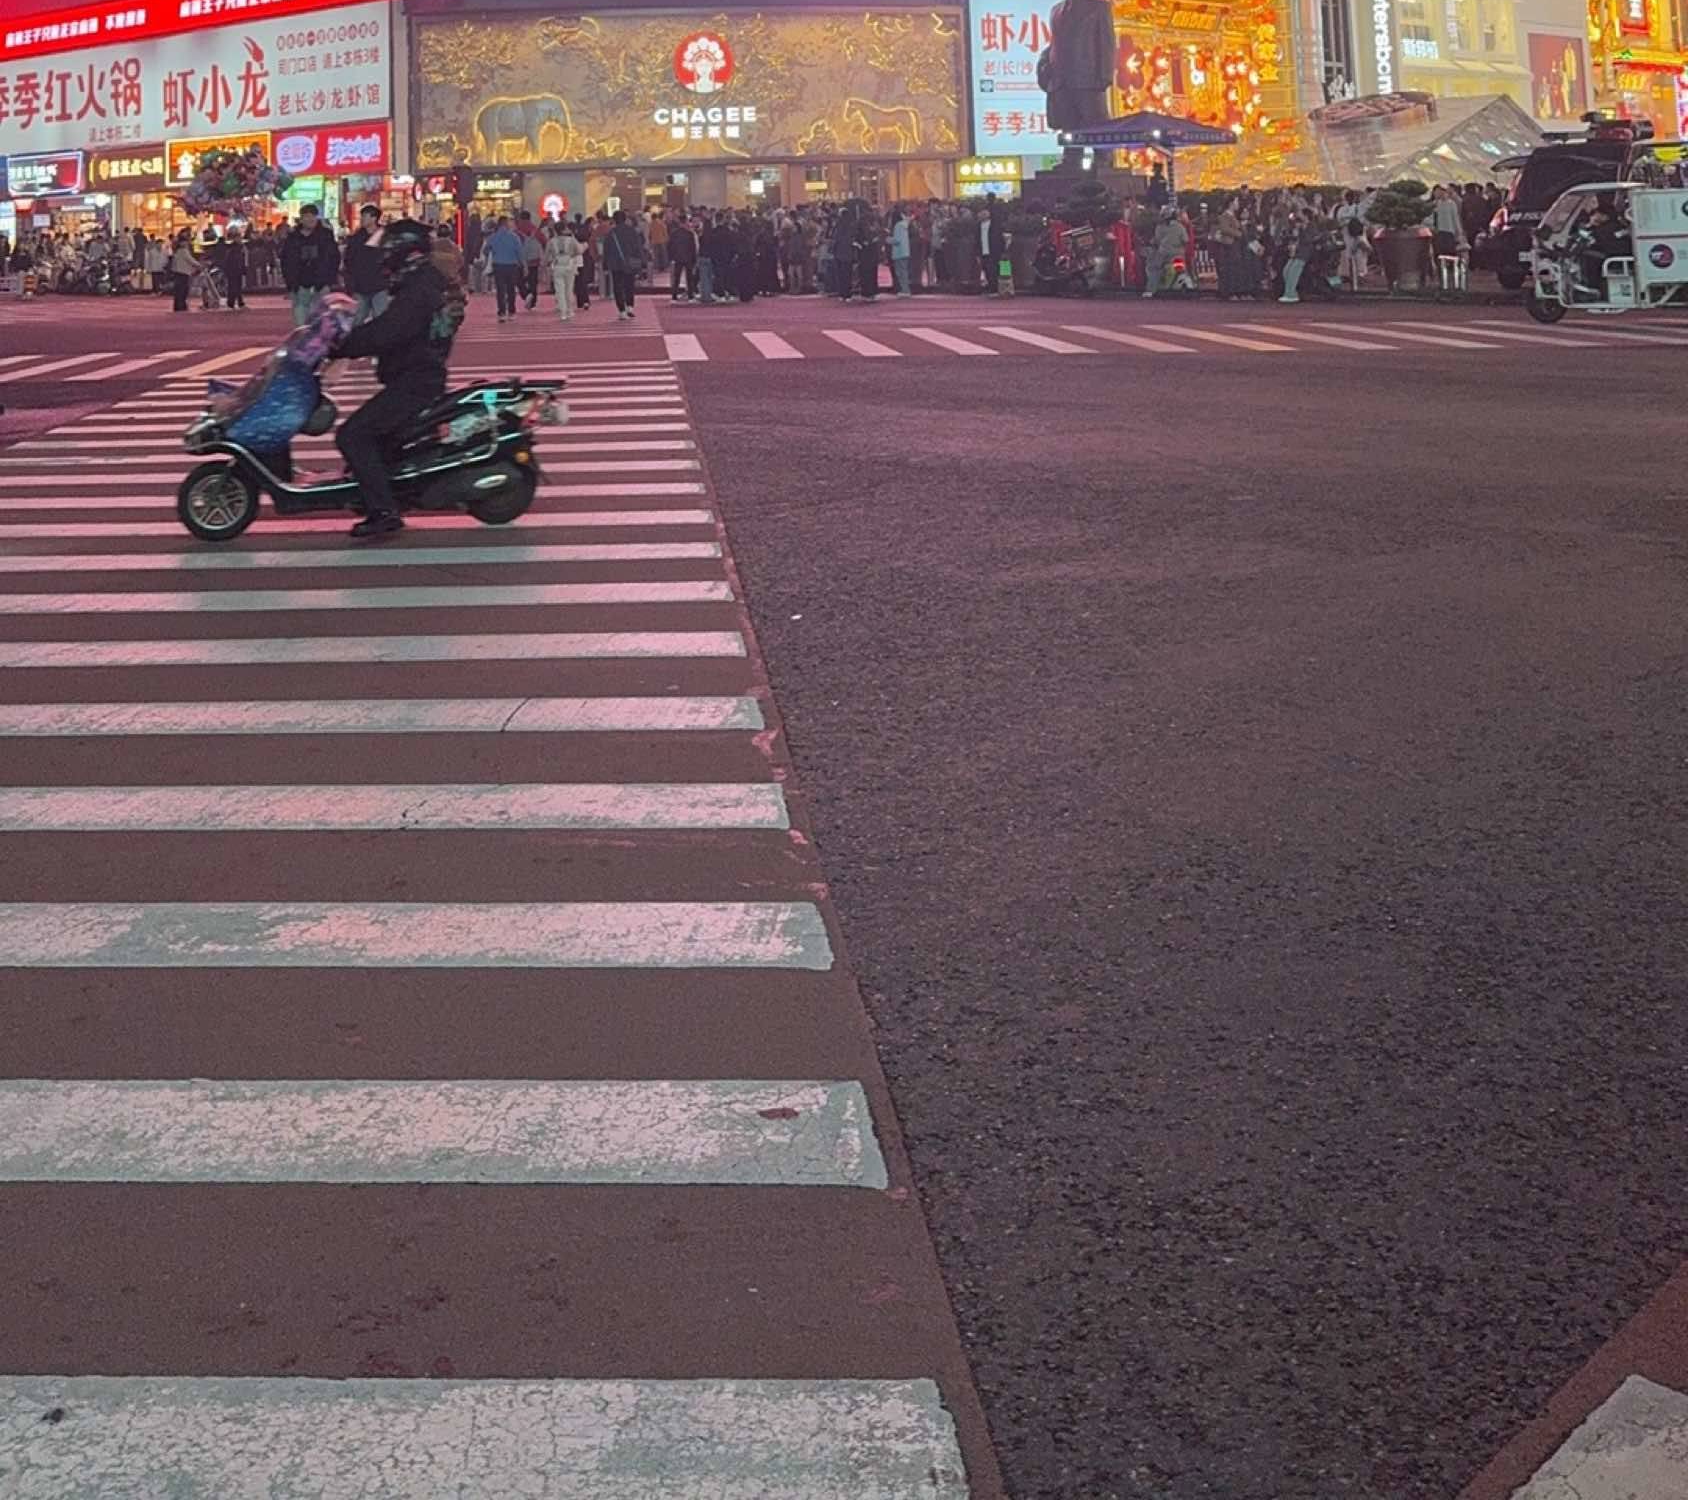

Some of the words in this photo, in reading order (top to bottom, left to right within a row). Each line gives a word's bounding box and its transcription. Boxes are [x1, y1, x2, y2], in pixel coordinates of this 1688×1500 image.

[163, 58, 271, 128] 虾小龙
[653, 106, 758, 125] CHAGEE
